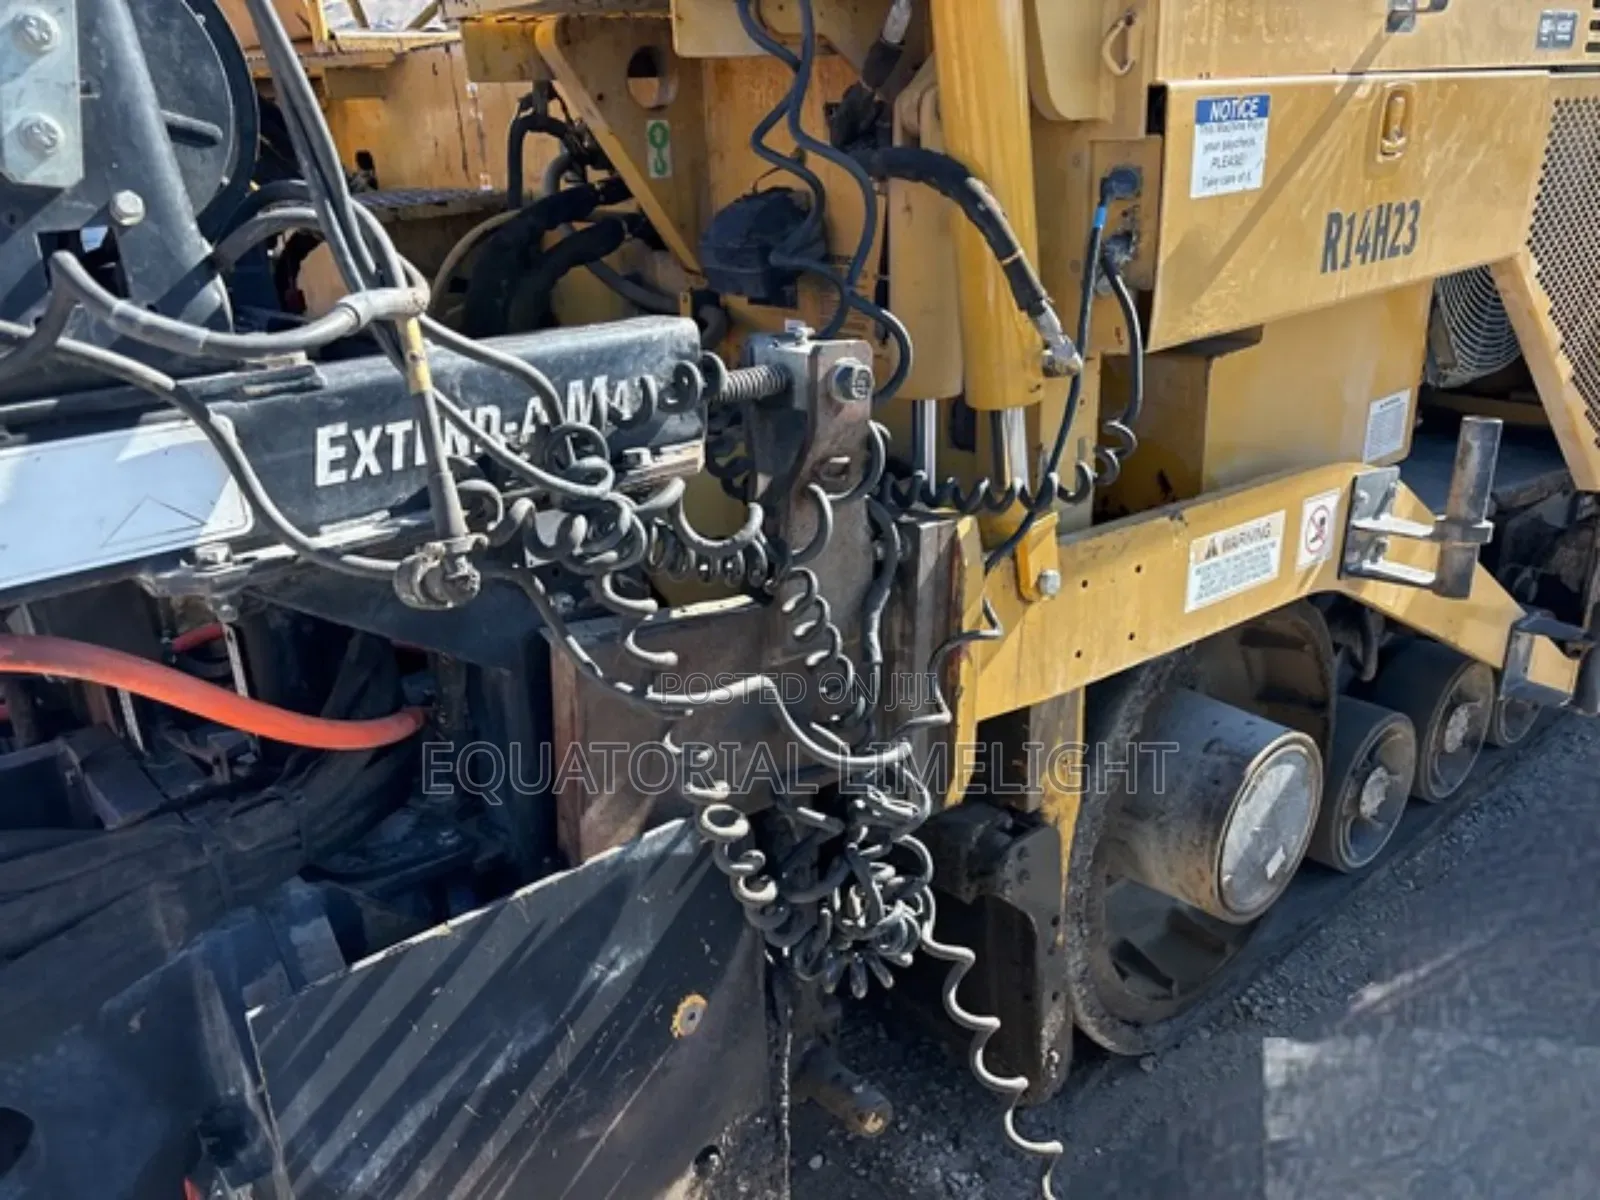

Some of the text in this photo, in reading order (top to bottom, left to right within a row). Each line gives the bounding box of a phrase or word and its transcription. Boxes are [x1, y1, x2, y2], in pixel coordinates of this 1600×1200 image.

[1210, 98, 1260, 122] NOTICE
[1321, 199, 1420, 274] R14H23
[1222, 522, 1271, 553] WARNING
